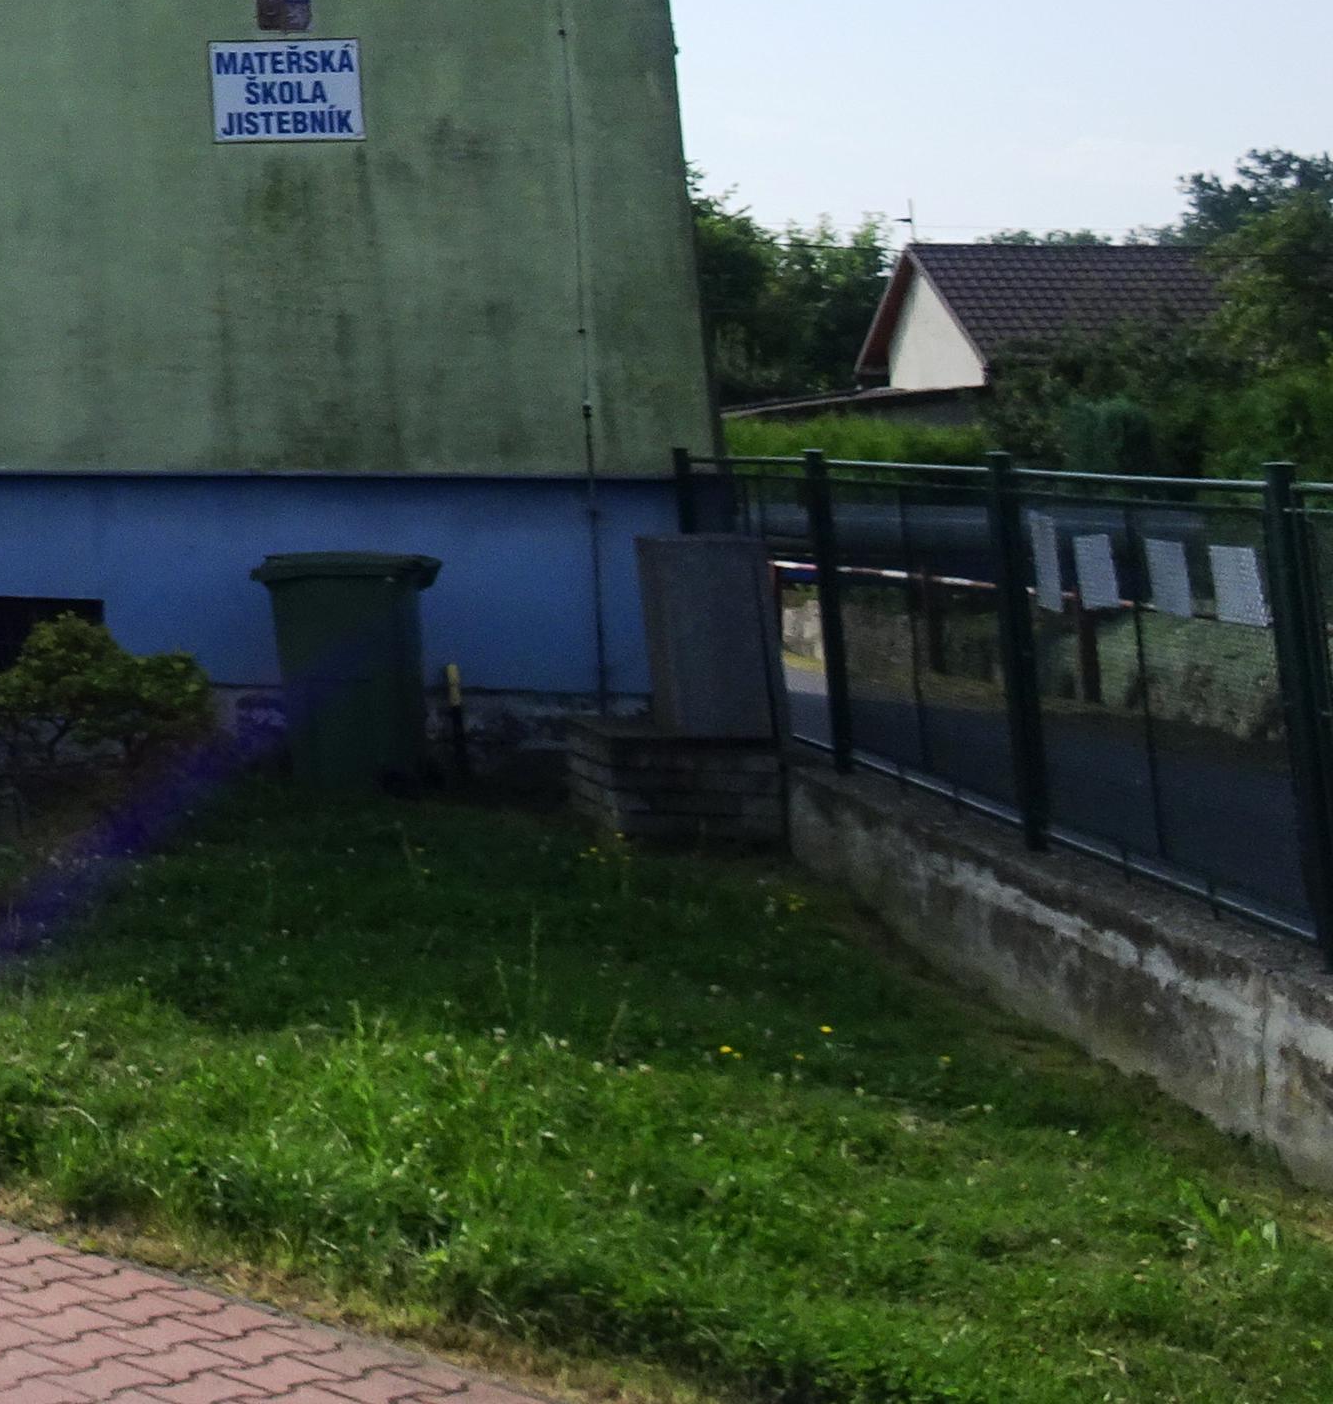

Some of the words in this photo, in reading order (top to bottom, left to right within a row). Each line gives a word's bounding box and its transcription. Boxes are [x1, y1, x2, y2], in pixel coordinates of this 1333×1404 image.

[216, 45, 354, 75] MATEŘSKÁ
[244, 76, 328, 105] ŠKOLA
[221, 105, 354, 136] JISTEBNÍK
